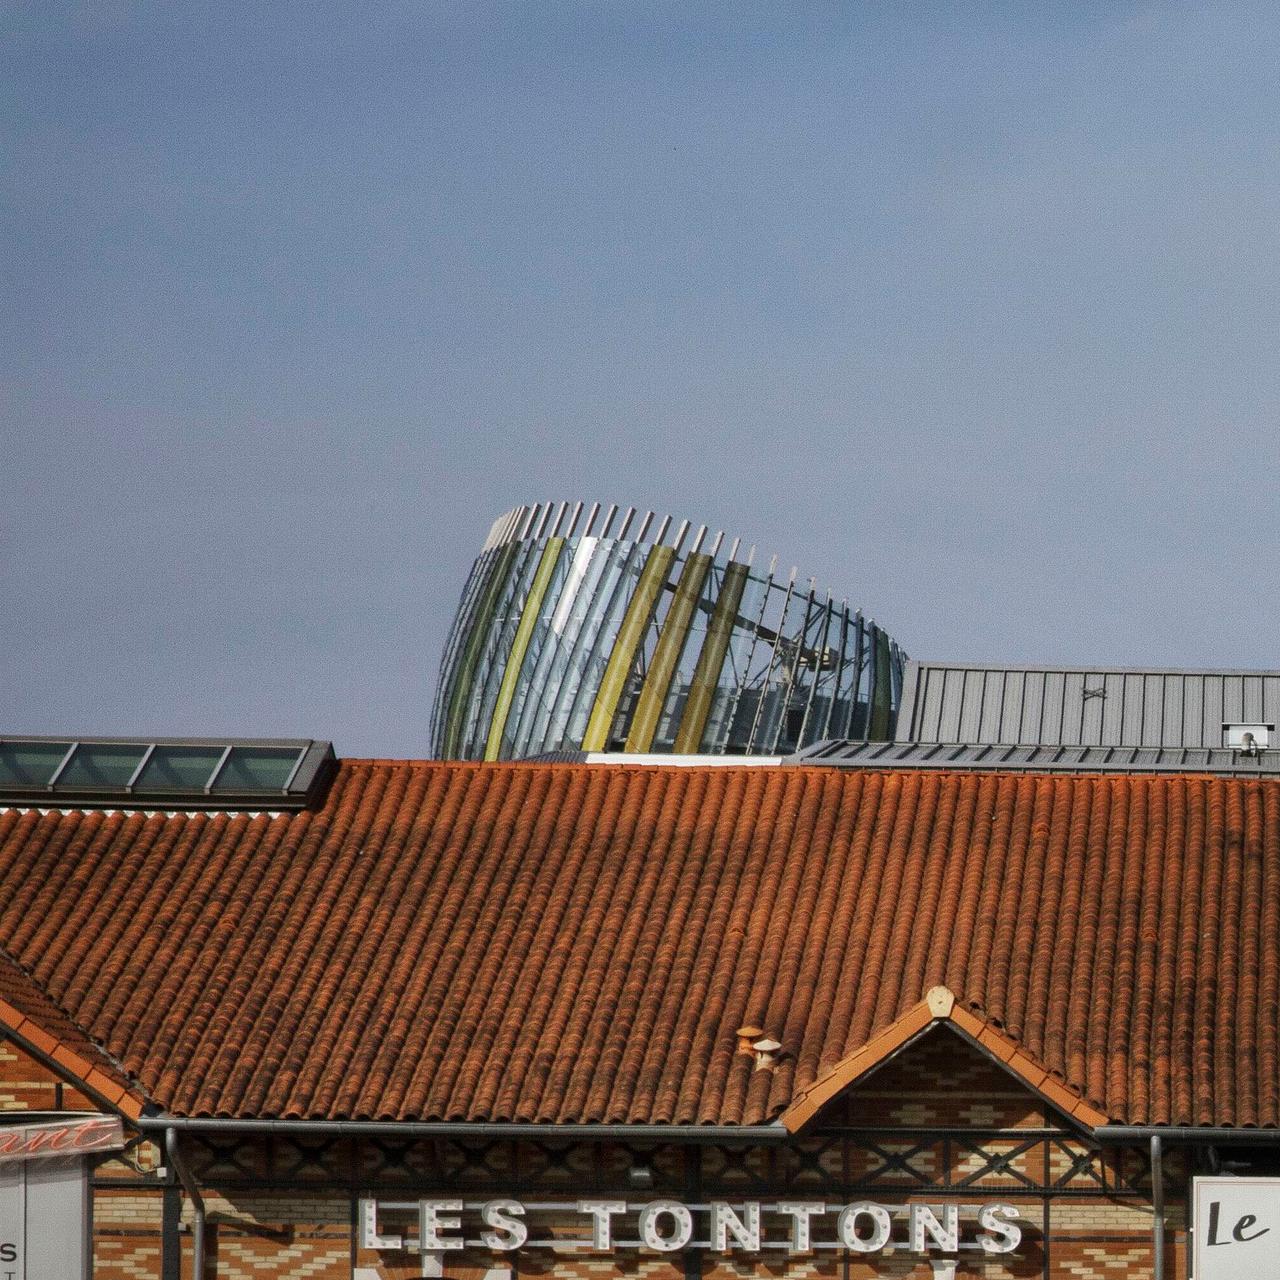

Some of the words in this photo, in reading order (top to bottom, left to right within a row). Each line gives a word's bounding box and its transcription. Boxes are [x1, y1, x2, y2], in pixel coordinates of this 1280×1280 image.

[359, 1198, 528, 1252] LES
[577, 1198, 1023, 1253] TONTONS
[1207, 1201, 1270, 1247] Le
